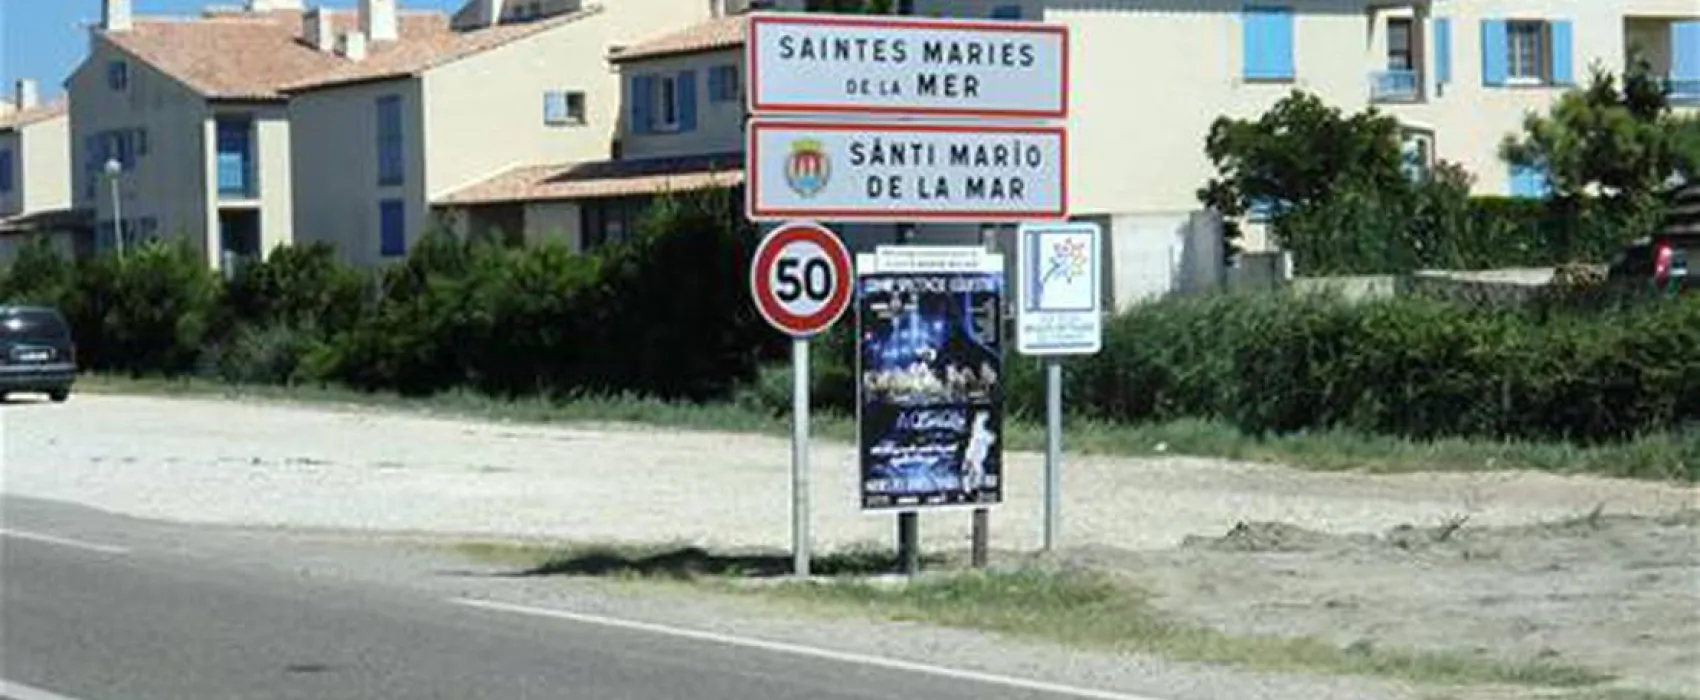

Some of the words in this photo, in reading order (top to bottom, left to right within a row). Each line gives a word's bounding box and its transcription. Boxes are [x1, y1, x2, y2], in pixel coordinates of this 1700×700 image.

[778, 35, 907, 63] SAINTES
[922, 41, 1035, 67] MARIES
[845, 79, 869, 95] DE
[879, 80, 901, 95] LA
[916, 73, 981, 98] MER
[866, 176, 903, 198] DE
[917, 177, 951, 200] LA
[964, 177, 1026, 200] MAR
[776, 257, 833, 302] 50
